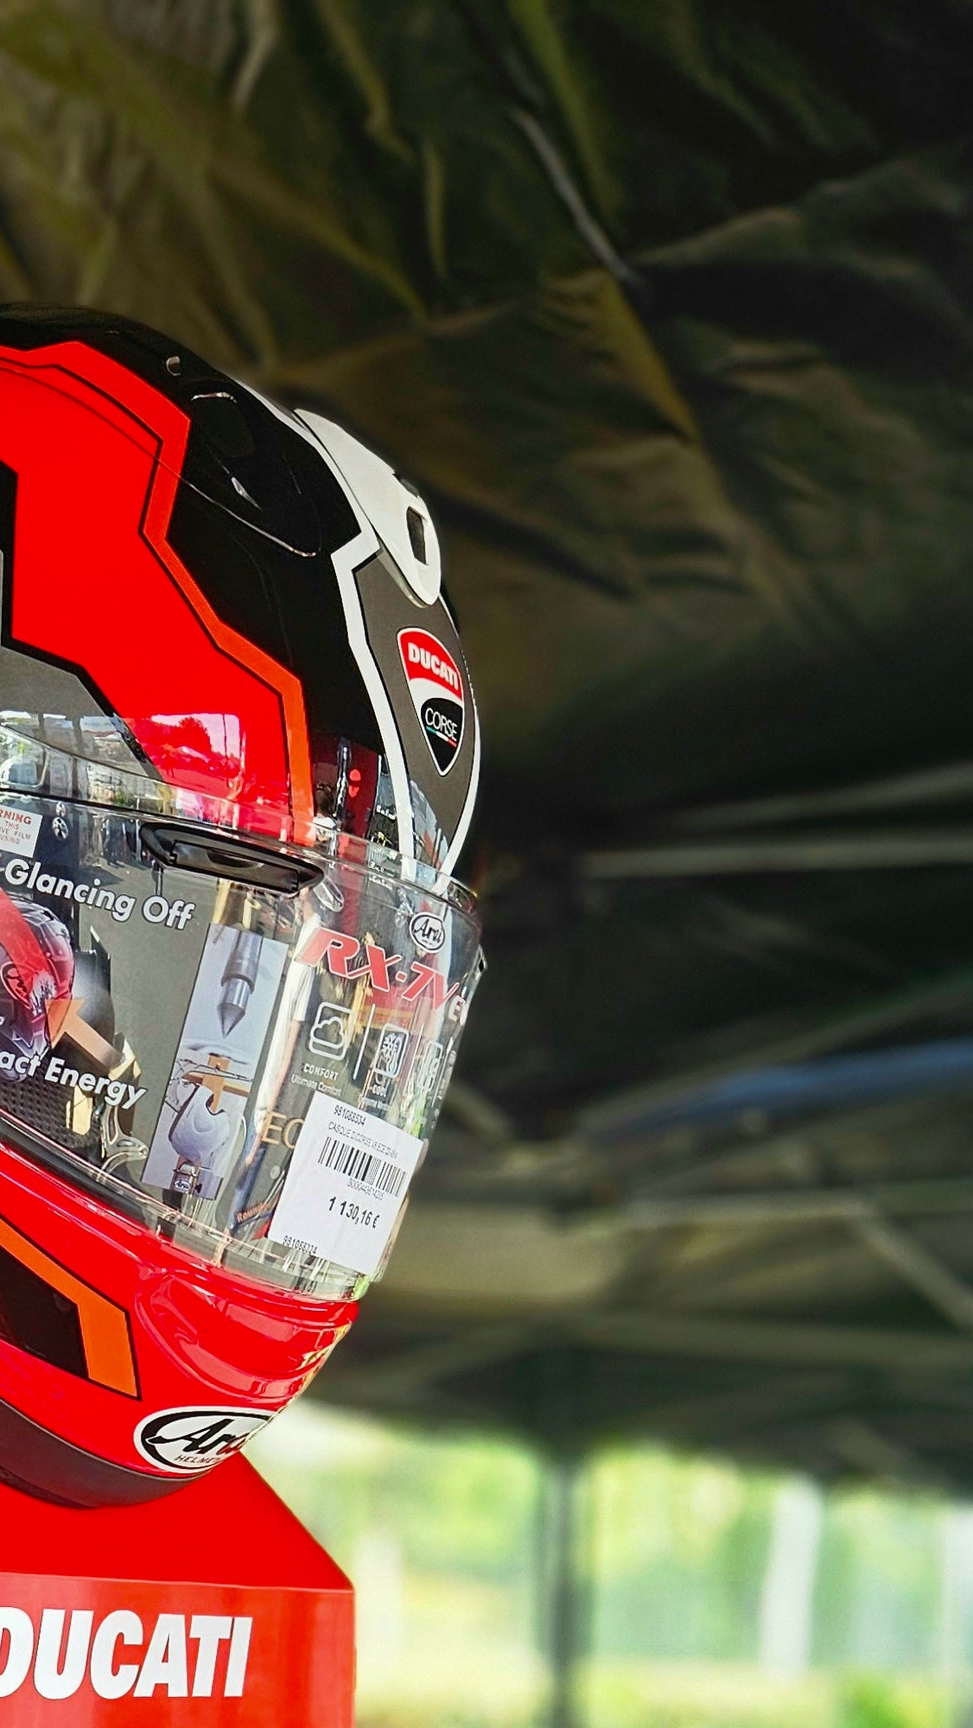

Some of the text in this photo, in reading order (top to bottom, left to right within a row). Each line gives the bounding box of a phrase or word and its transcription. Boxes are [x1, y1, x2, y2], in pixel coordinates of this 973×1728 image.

[407, 642, 458, 690] DUCATI
[425, 707, 458, 742] CORSE
[0, 833, 20, 845] USING
[5, 820, 19, 830] THIS
[14, 830, 31, 840] FILM
[4, 858, 196, 930] Glancing Off
[44, 1056, 147, 1110] Energy
[302, 1063, 339, 1081] COMFORT
[328, 1196, 380, 1229] 1 130,16 €
[147, 1418, 250, 1456] Ara
